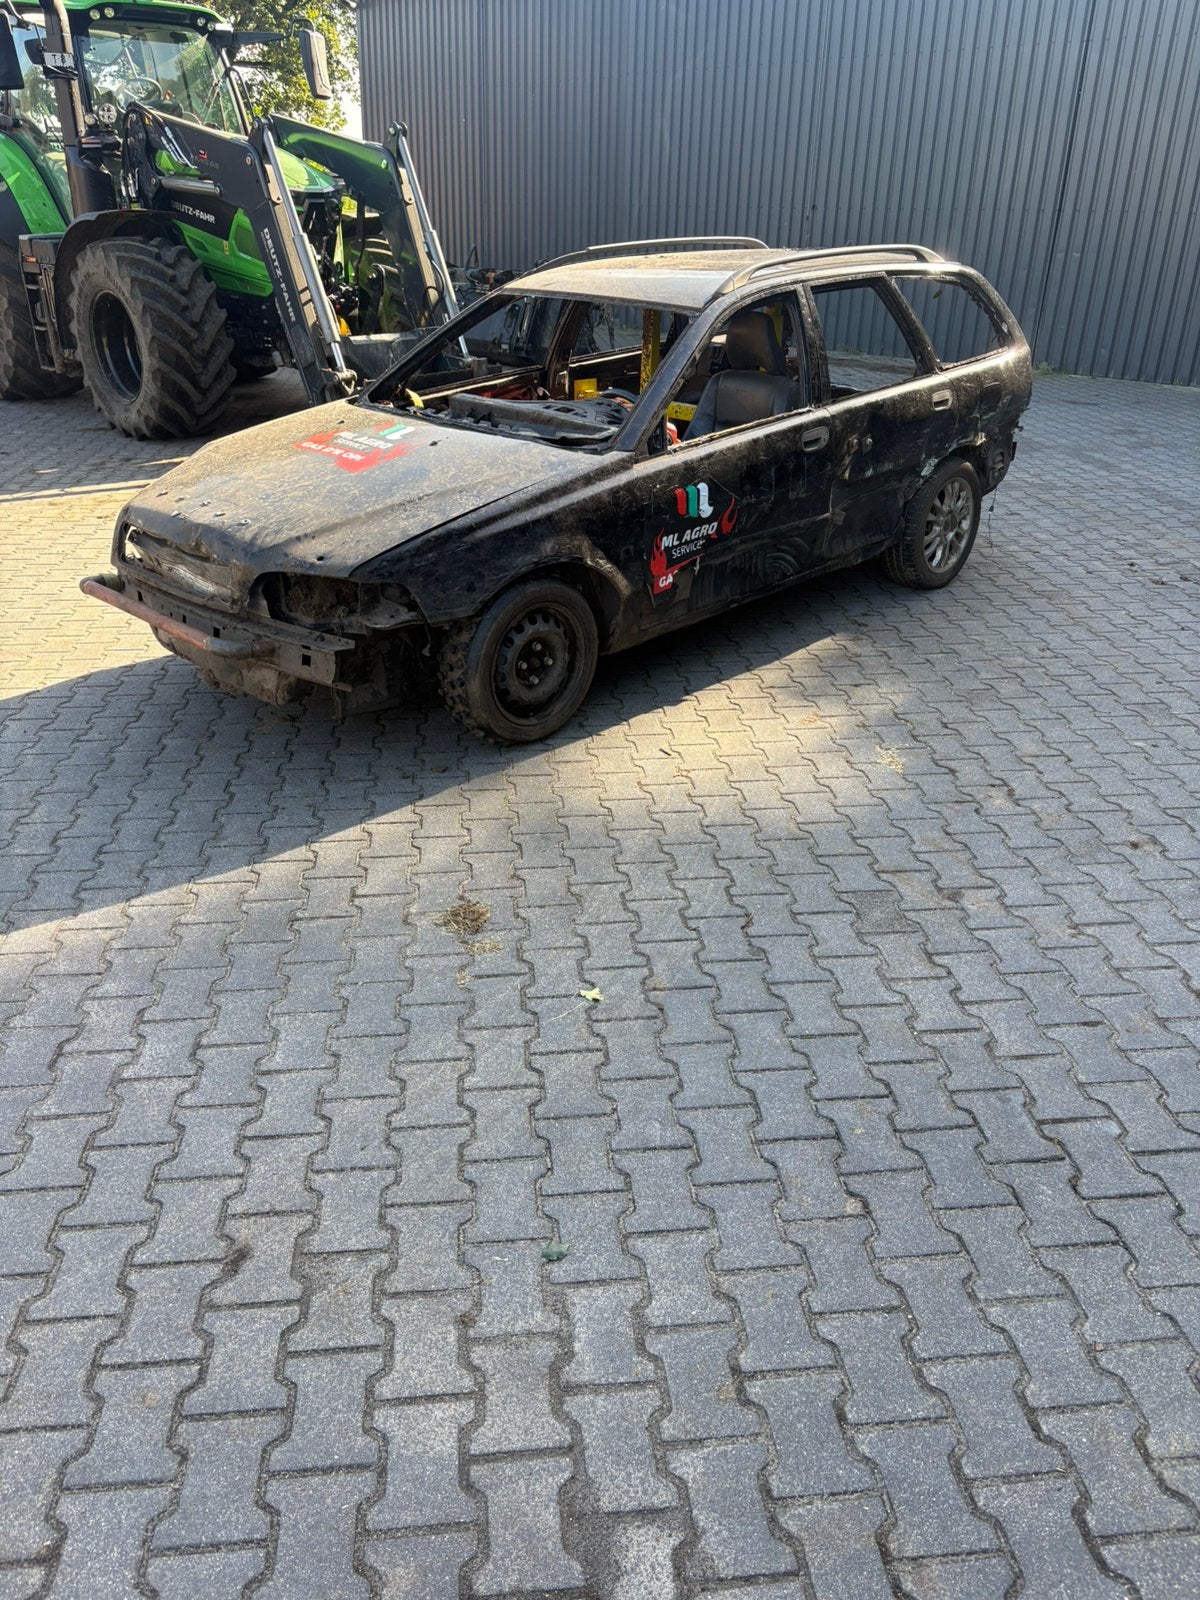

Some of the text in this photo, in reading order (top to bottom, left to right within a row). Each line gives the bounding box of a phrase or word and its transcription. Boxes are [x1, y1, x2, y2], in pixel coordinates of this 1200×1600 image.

[170, 200, 216, 224] DEUTZ-FAHR
[263, 227, 296, 322] DEUTZ-FAHR
[354, 436, 394, 449] AGRO
[661, 521, 718, 550] ML AGRO
[671, 540, 702, 559] SERVICE
[659, 570, 679, 587] GA
